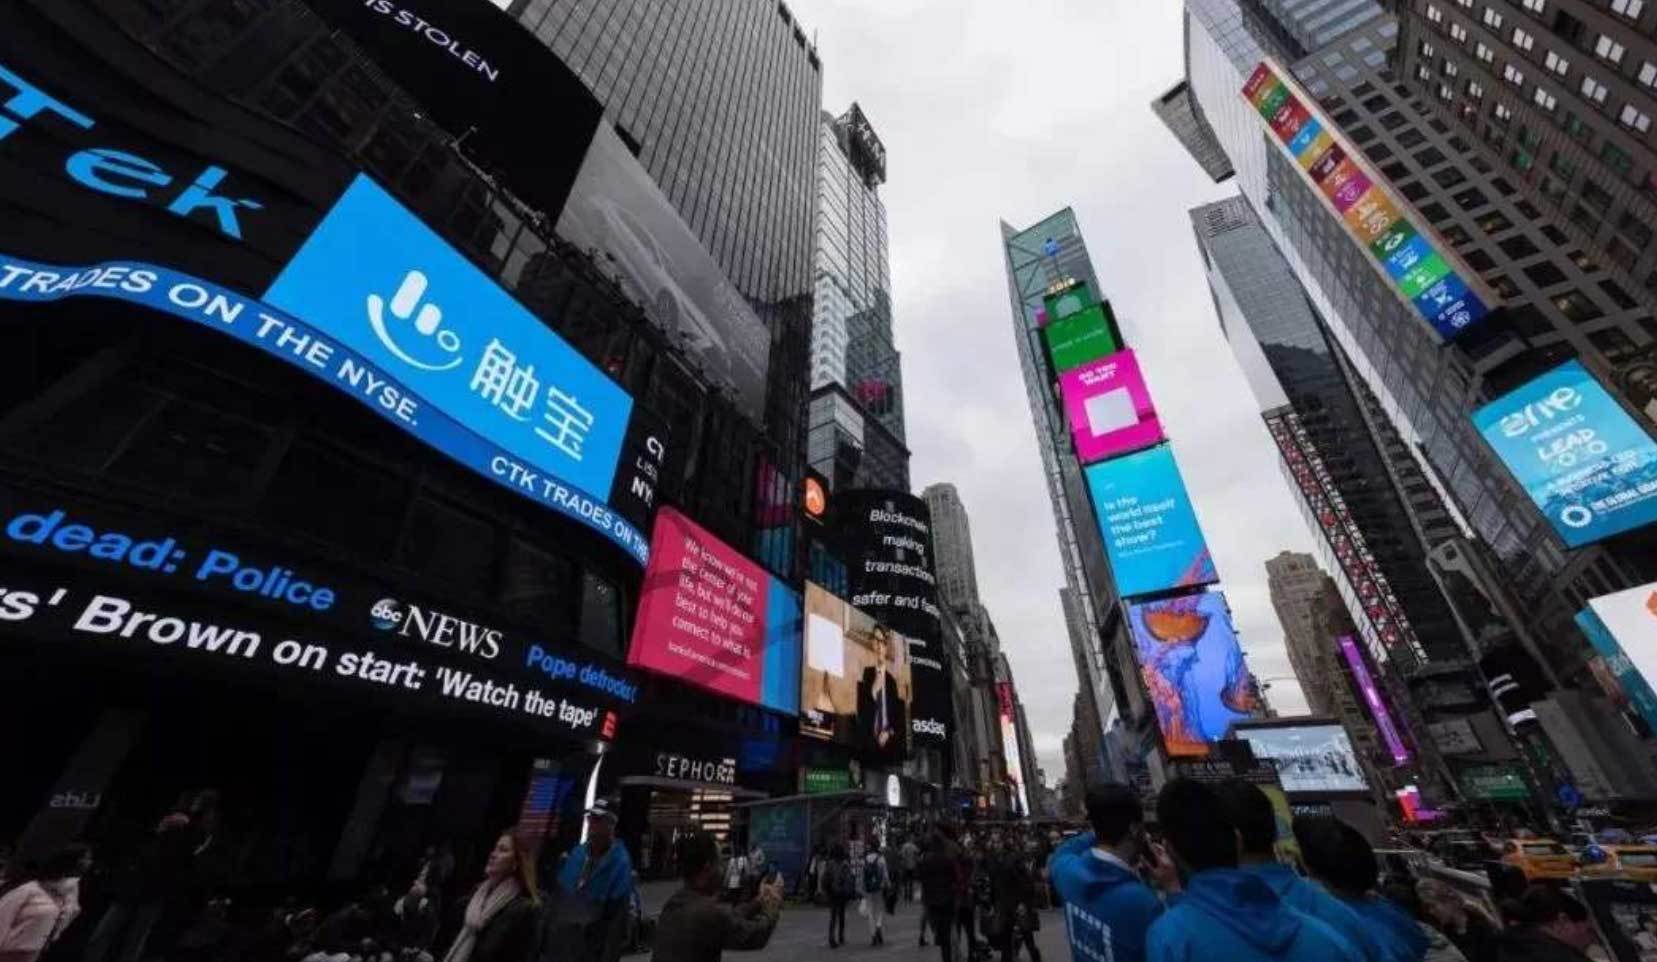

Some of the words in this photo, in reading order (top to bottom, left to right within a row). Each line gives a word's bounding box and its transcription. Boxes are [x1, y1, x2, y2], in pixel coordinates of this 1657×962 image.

[394, 9, 499, 81] STOLEN
[0, 265, 157, 293] TRADES
[168, 284, 244, 323] ON
[256, 313, 334, 368] THE
[337, 358, 418, 426] NYSE.
[470, 337, 594, 461] 触宝
[491, 456, 537, 492] CTK
[542, 479, 613, 529] TRADES
[614, 521, 633, 544] ON
[6, 509, 186, 573] dead:
[195, 549, 335, 611] Police
[882, 535, 924, 556] making
[370, 603, 402, 624] abc
[398, 604, 504, 660] NEWS
[852, 590, 891, 607] safer
[894, 595, 919, 610] and
[0, 587, 67, 621] s'
[73, 595, 261, 658] Brown
[272, 639, 329, 670] on
[336, 651, 425, 690] start:
[436, 666, 520, 709] 'Watch
[524, 689, 555, 717] the
[558, 698, 599, 729] tape'
[526, 642, 576, 680] Pope
[655, 753, 735, 785] SEPHORA
